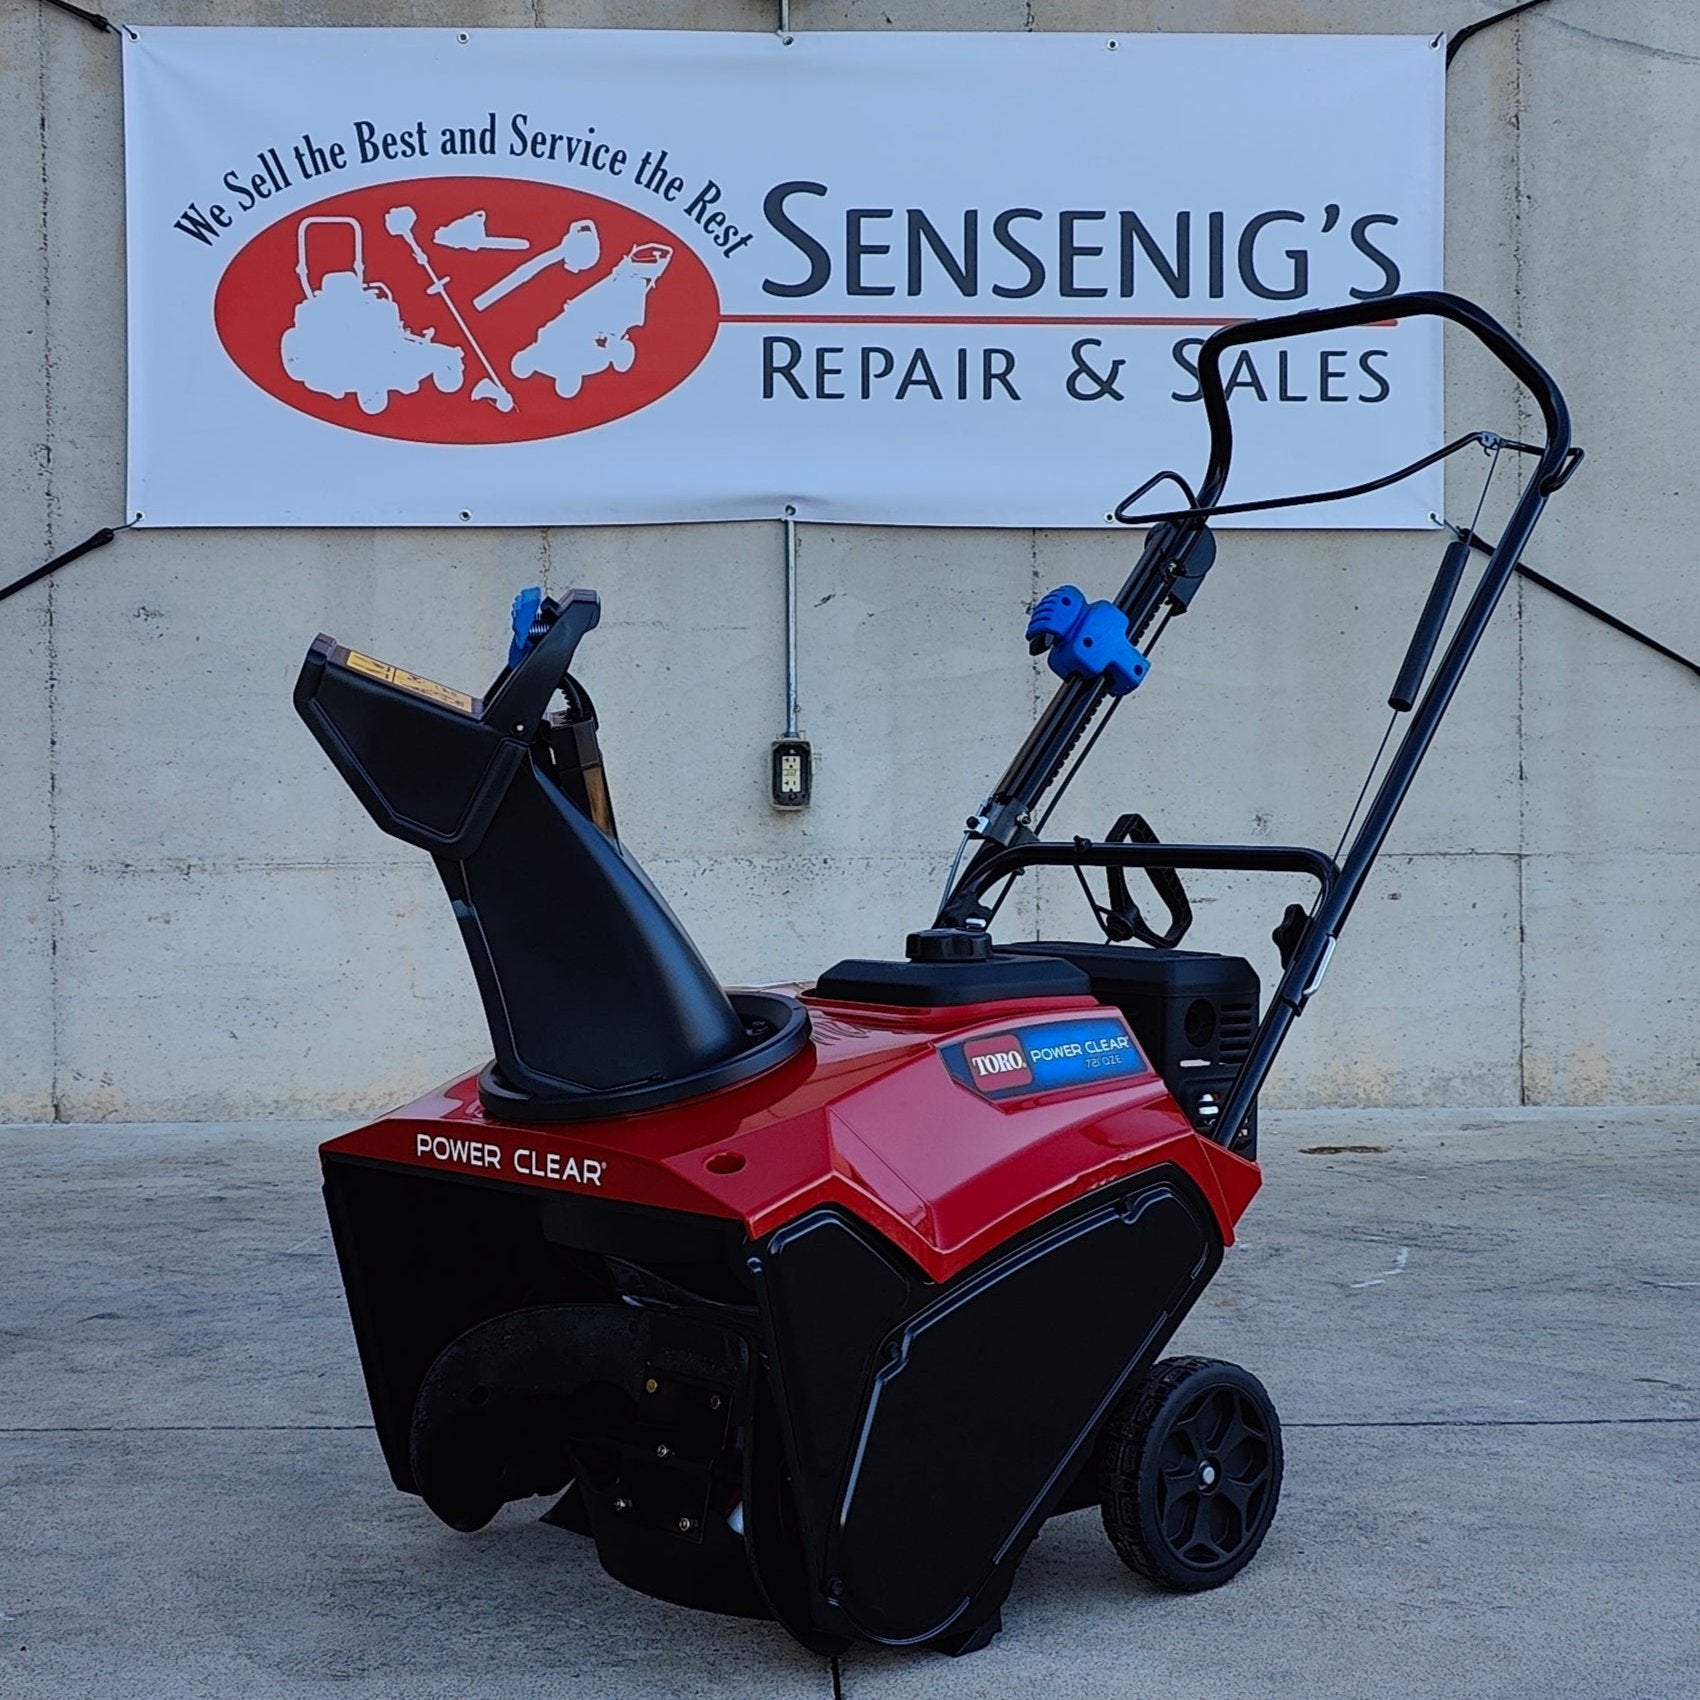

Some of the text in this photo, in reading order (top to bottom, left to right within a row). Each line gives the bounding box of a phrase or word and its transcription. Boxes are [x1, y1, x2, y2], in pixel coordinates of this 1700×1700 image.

[173, 112, 754, 259] We Sell the Best and Service the Rest
[761, 180, 1401, 301] SENSENIG'S
[762, 335, 1390, 403] REPAIR & SALES
[972, 1050, 1023, 1077] TORO
[1030, 1036, 1130, 1063] POWER CLEAR
[416, 1133, 602, 1187] POWER CLEAR
